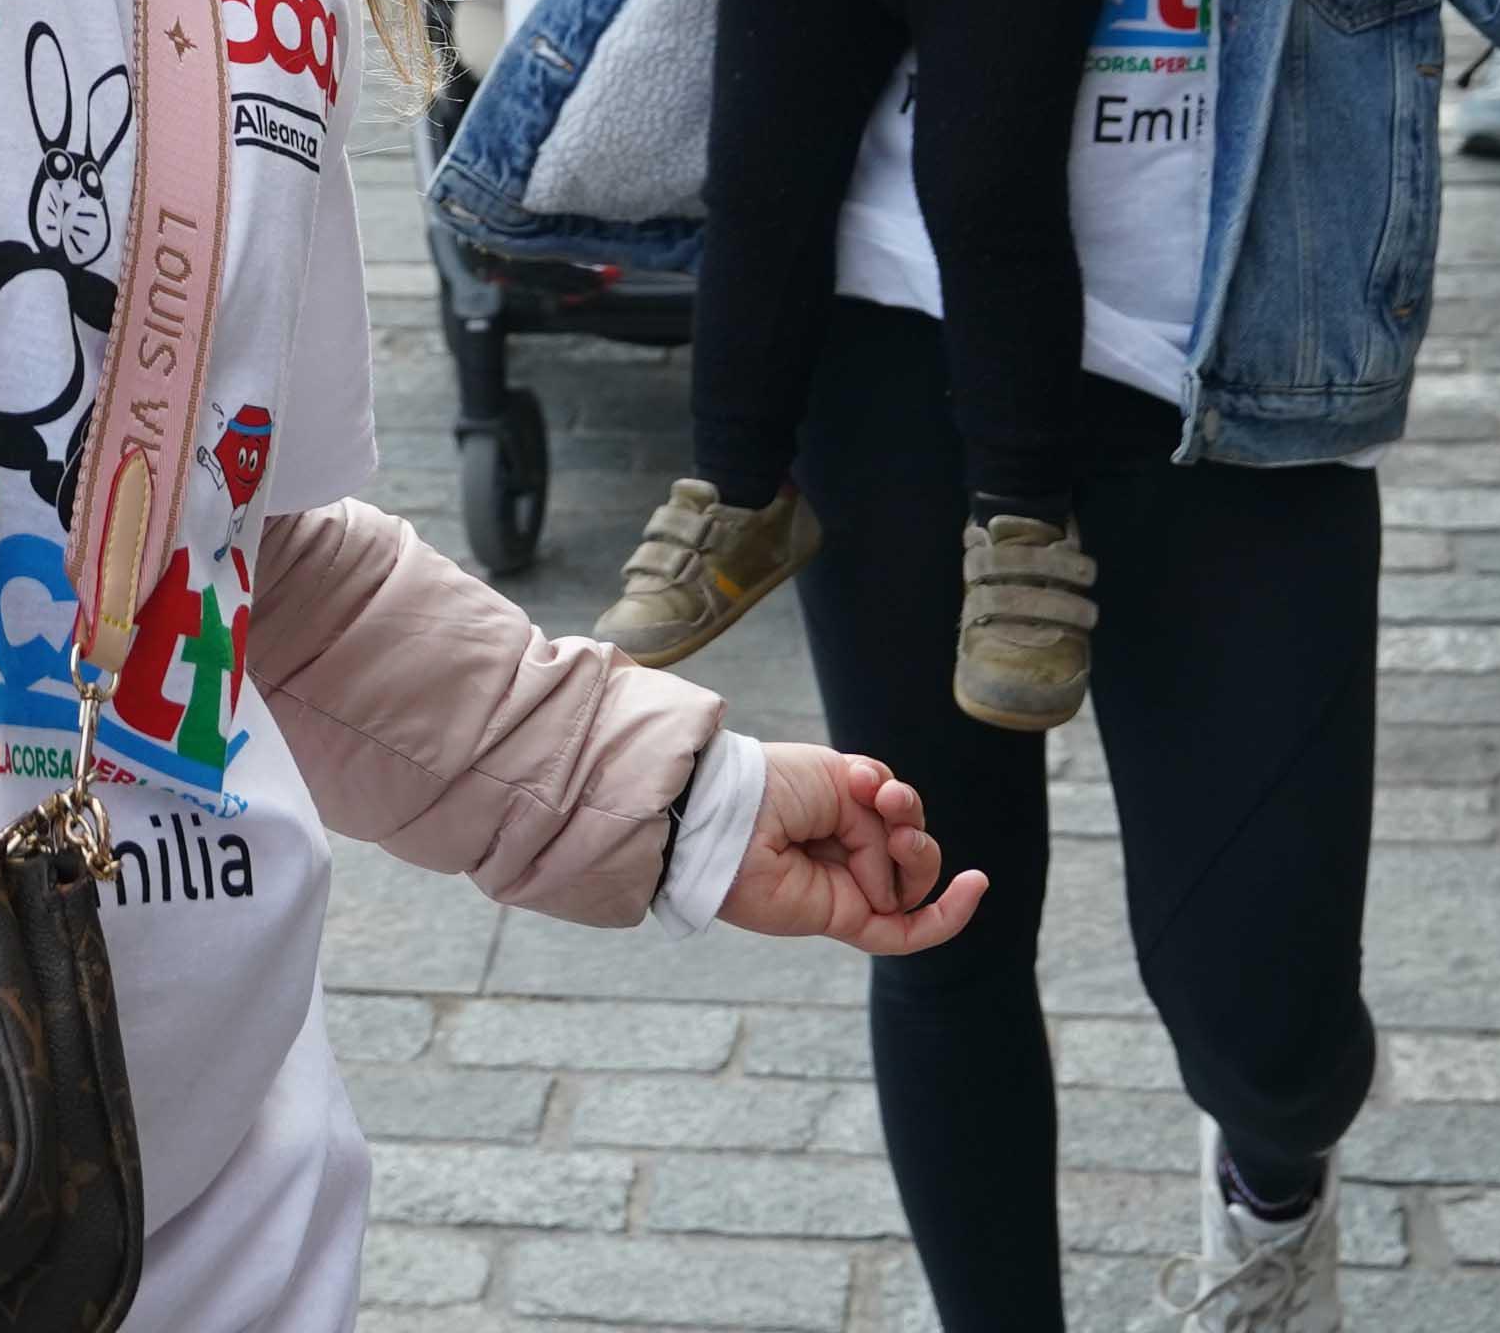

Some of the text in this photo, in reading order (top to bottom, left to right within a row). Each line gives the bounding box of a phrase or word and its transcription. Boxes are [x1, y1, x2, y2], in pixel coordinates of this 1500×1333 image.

[233, 104, 318, 159] Alleanza
[137, 208, 198, 377] LOUIS
[96, 811, 254, 907] milia
